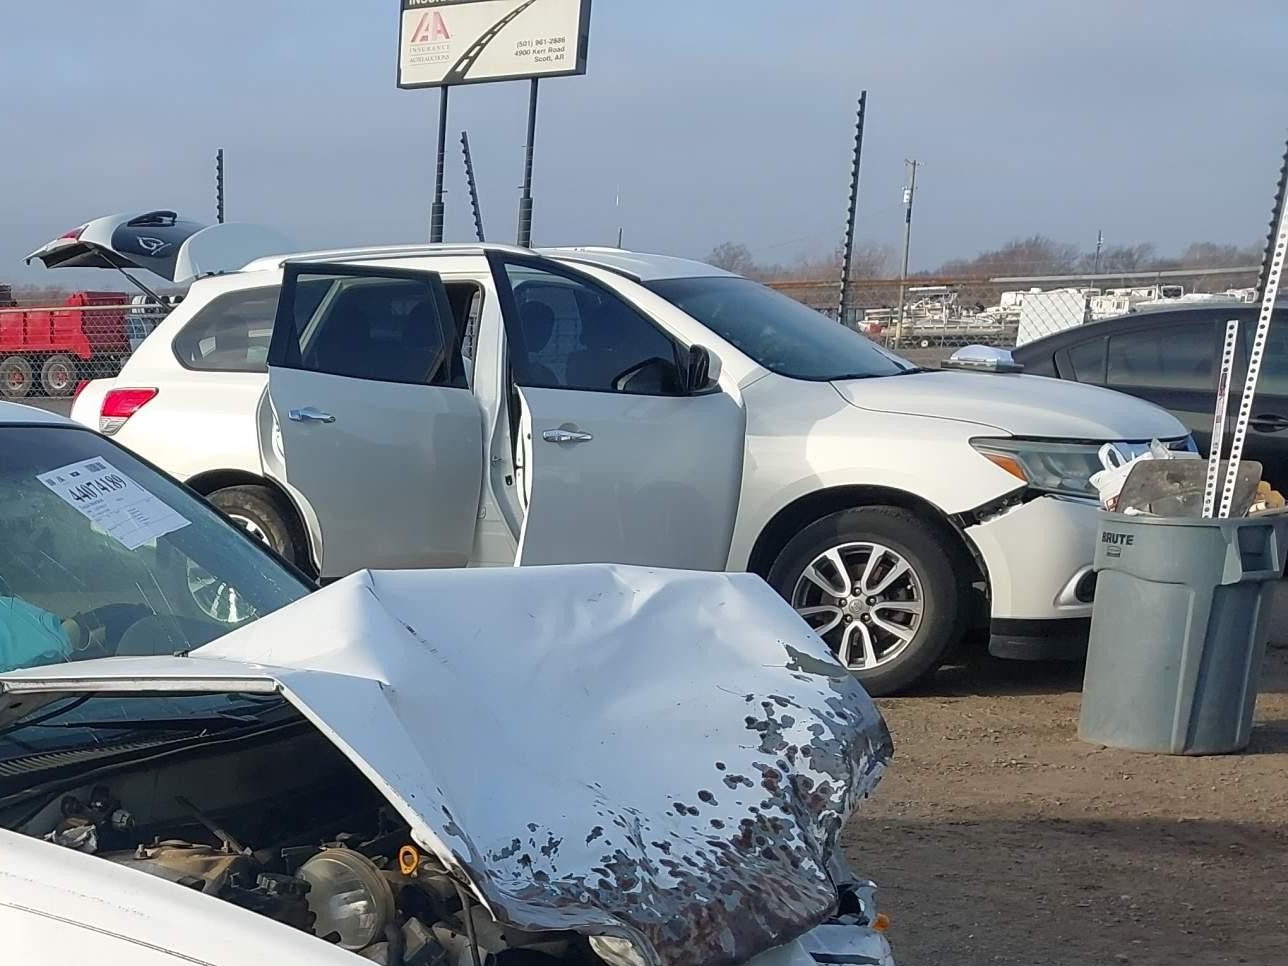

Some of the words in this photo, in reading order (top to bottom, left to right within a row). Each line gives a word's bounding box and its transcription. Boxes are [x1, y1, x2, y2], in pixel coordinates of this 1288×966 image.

[516, 40, 534, 49] (501)
[68, 473, 128, 503] 44074189
[1101, 531, 1135, 546] BRUTE
